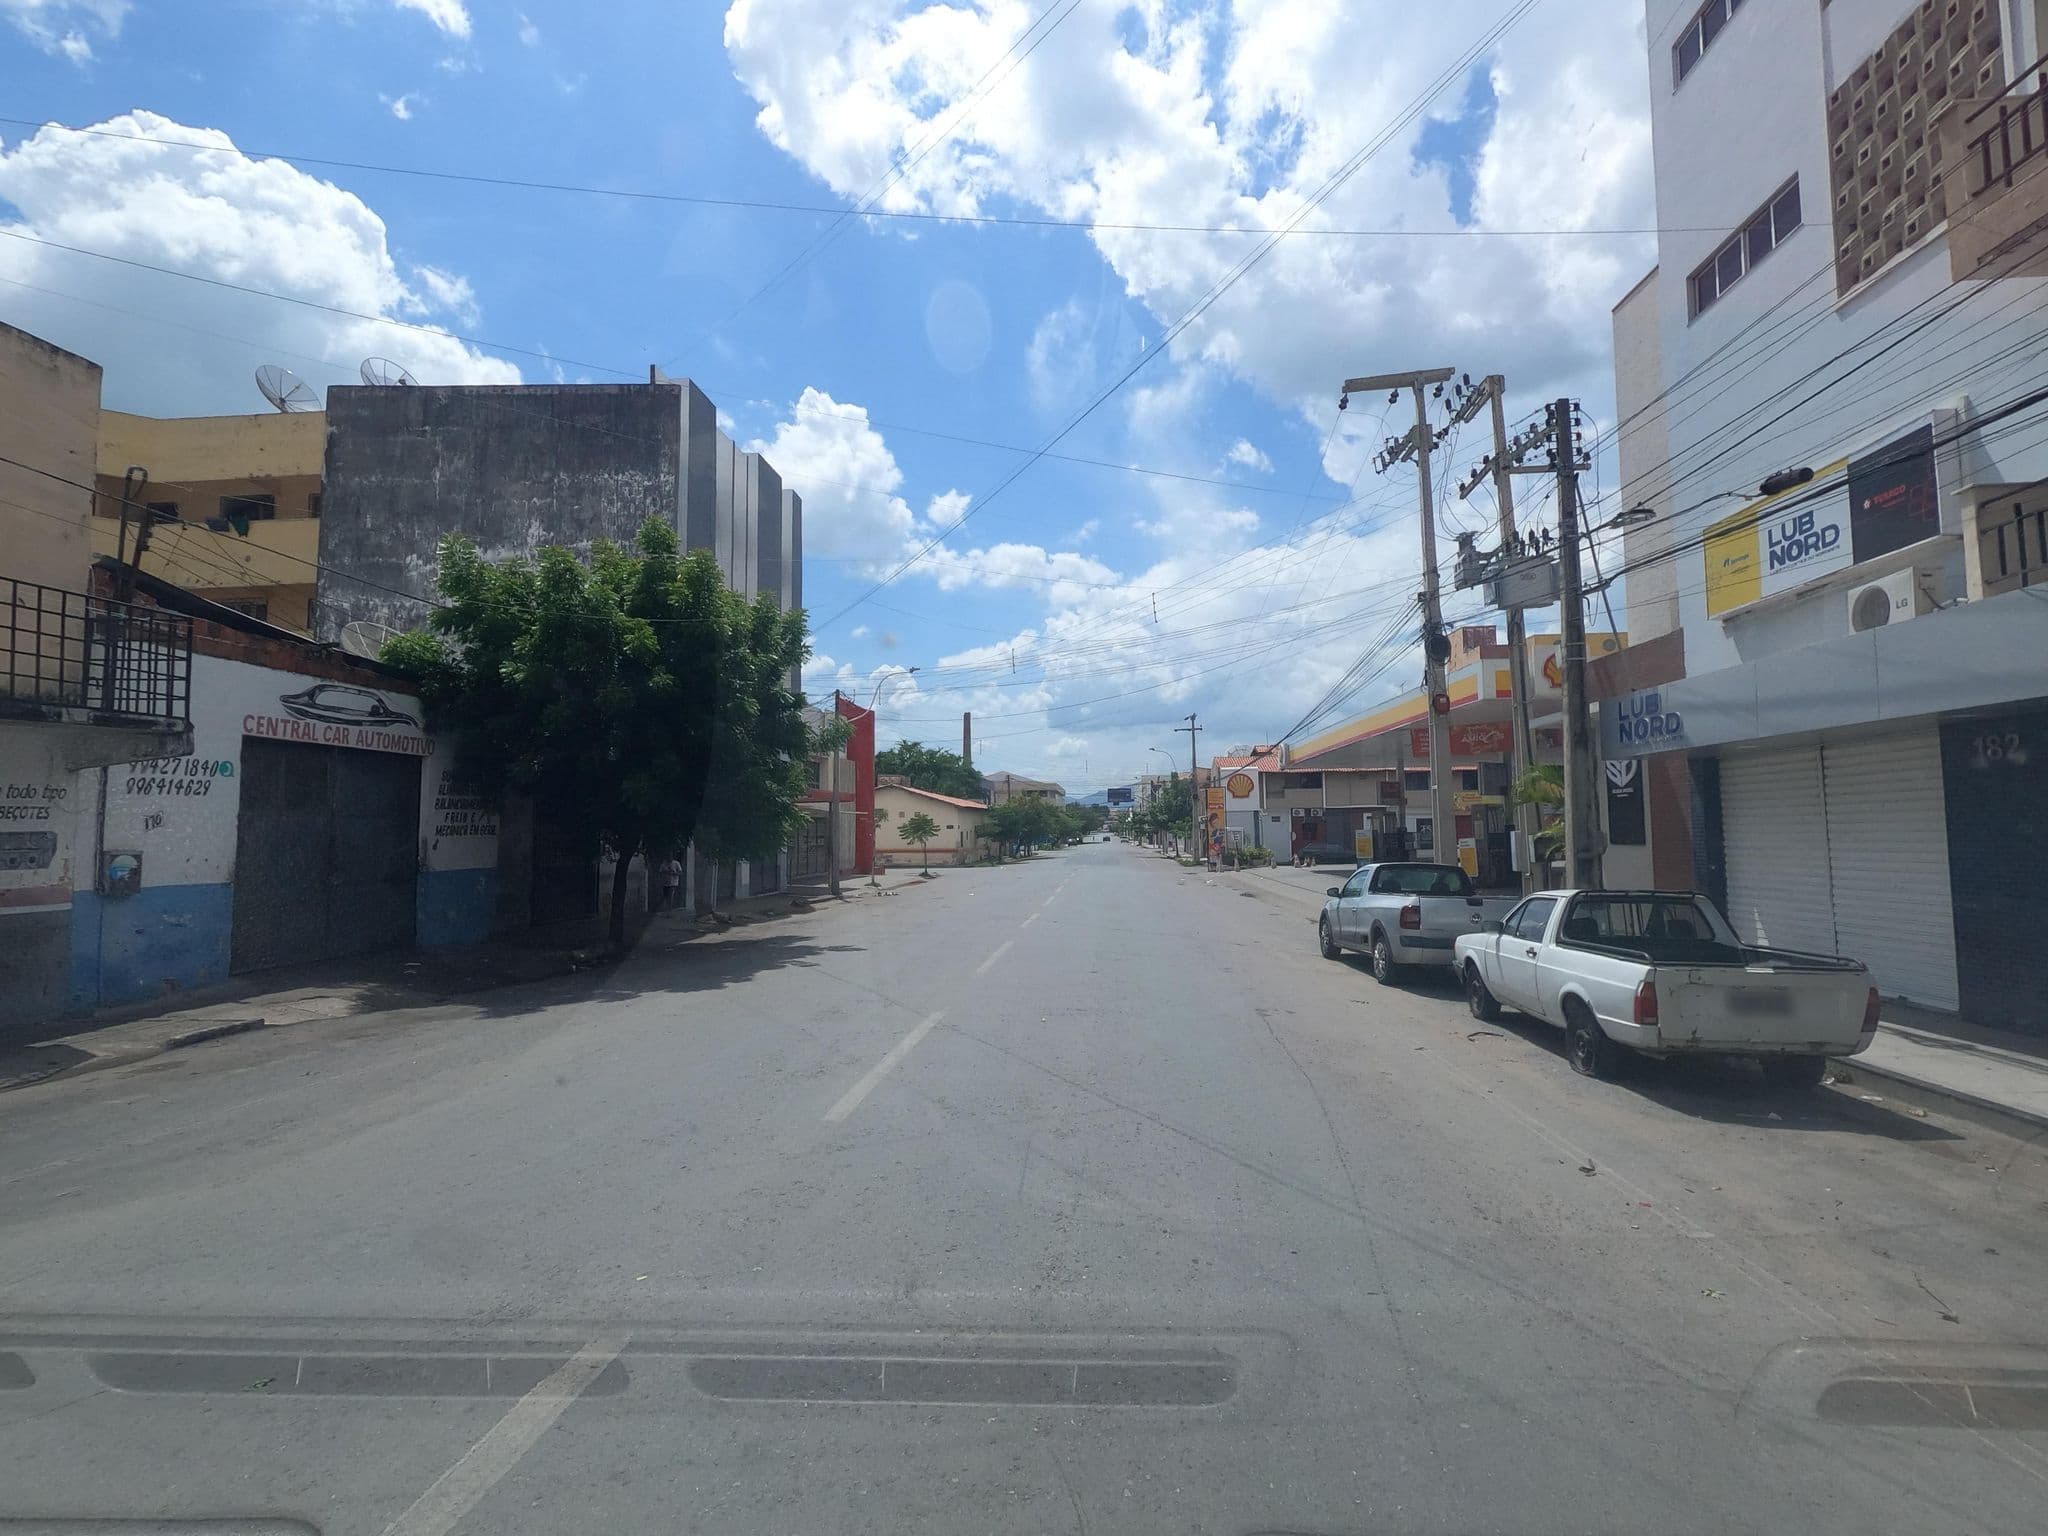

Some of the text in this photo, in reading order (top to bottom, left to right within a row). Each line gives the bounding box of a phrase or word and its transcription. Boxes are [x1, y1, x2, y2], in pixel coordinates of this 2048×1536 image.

[1767, 510, 1815, 549] LUB
[1769, 523, 1840, 571] NORD
[1896, 598, 1908, 609] LG
[1619, 693, 1660, 722] LUB
[242, 714, 436, 756] CENTRAL CAR AUTOMOTIVO
[1619, 711, 1681, 743] NORD
[6, 784, 37, 799] todo
[126, 777, 212, 796] 996414629
